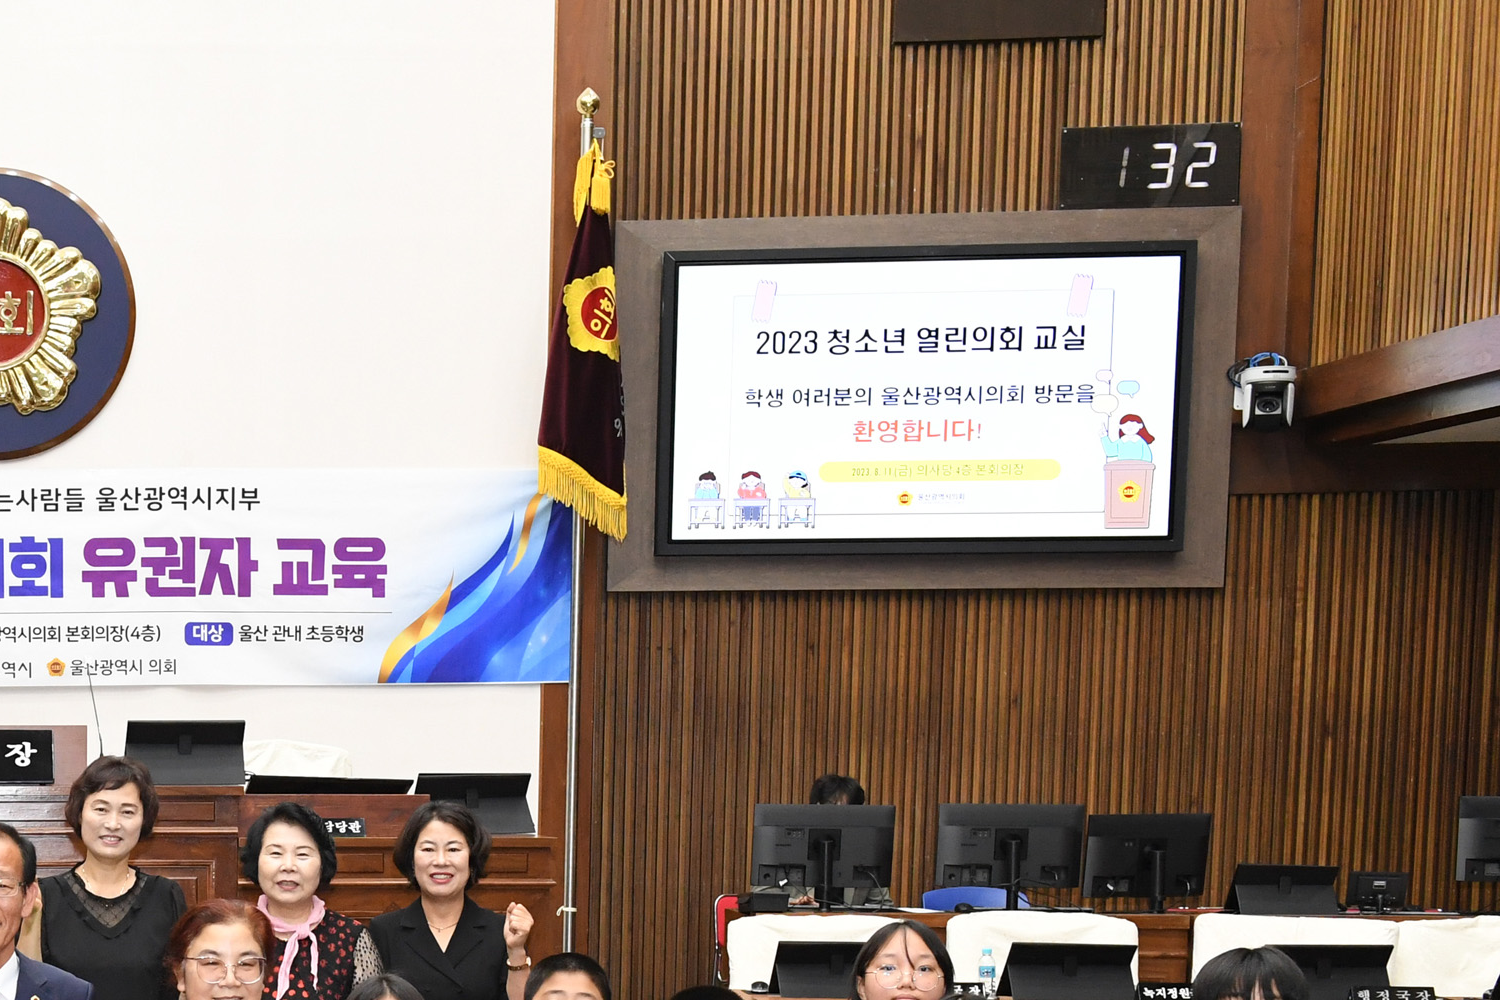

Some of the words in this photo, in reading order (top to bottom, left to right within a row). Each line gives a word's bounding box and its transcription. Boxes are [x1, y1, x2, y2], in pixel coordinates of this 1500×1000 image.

[756, 330, 818, 354] 2023
[827, 328, 905, 355] 청소년
[917, 326, 1023, 353] 열린의회
[1034, 325, 1085, 350] 교실
[746, 389, 783, 408] 학생
[793, 387, 871, 407] 여러분의
[881, 385, 1024, 406] 울산광역시의회
[1035, 384, 1095, 404] 방문을
[853, 419, 981, 443] 환영합니다!
[96, 486, 260, 511] 울산광역시지부
[82, 537, 258, 598] 유권자
[273, 537, 387, 598] 교육
[65, 625, 160, 642] 본회의장(4층)
[192, 625, 224, 643] 대상
[239, 625, 268, 642] 울산
[272, 625, 301, 642] 관내
[306, 625, 363, 642] 초등학생
[70, 659, 144, 677] 울산광역시
[149, 659, 176, 675] 의회
